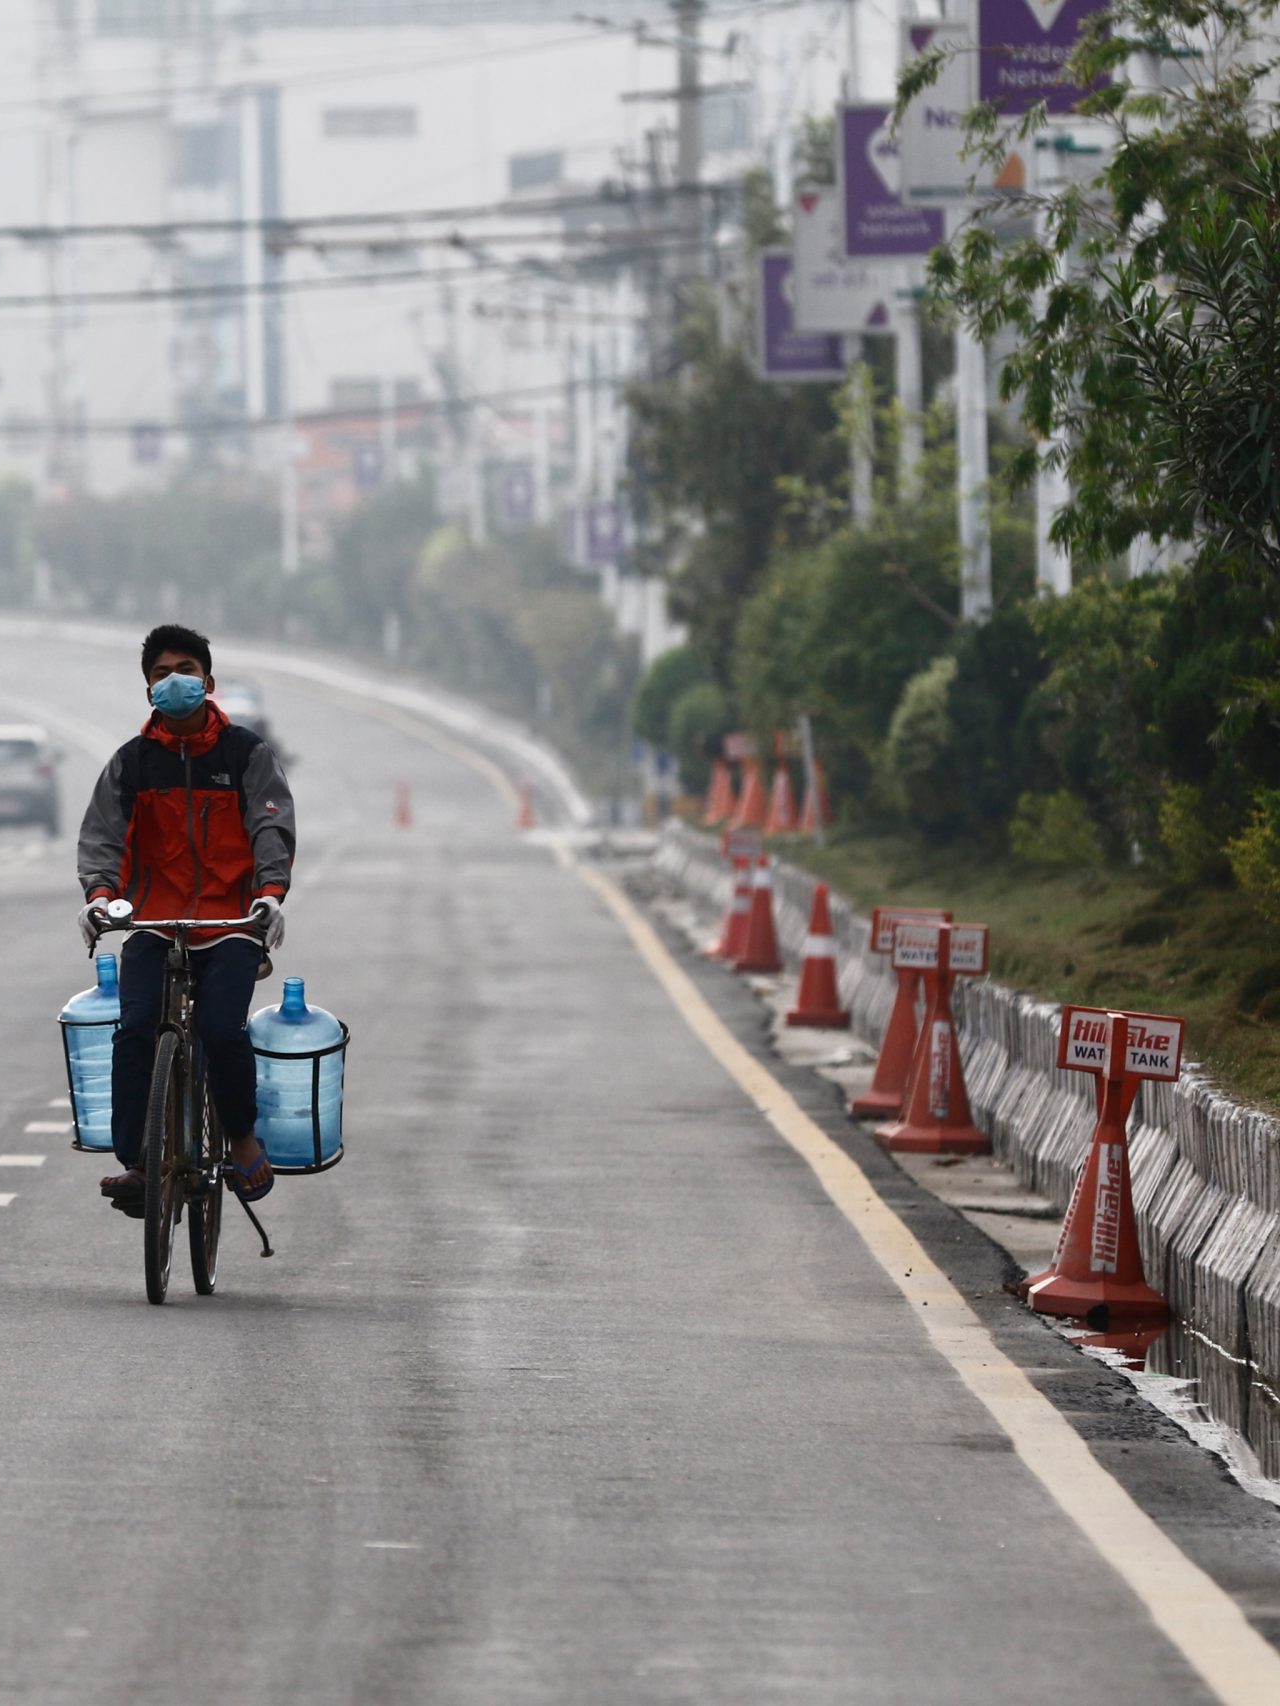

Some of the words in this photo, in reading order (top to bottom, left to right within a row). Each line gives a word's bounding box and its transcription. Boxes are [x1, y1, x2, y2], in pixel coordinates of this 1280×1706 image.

[1074, 1045, 1105, 1061] WAT
[1130, 1051, 1170, 1069] TANK
[1093, 1157, 1121, 1264] Hilltake
